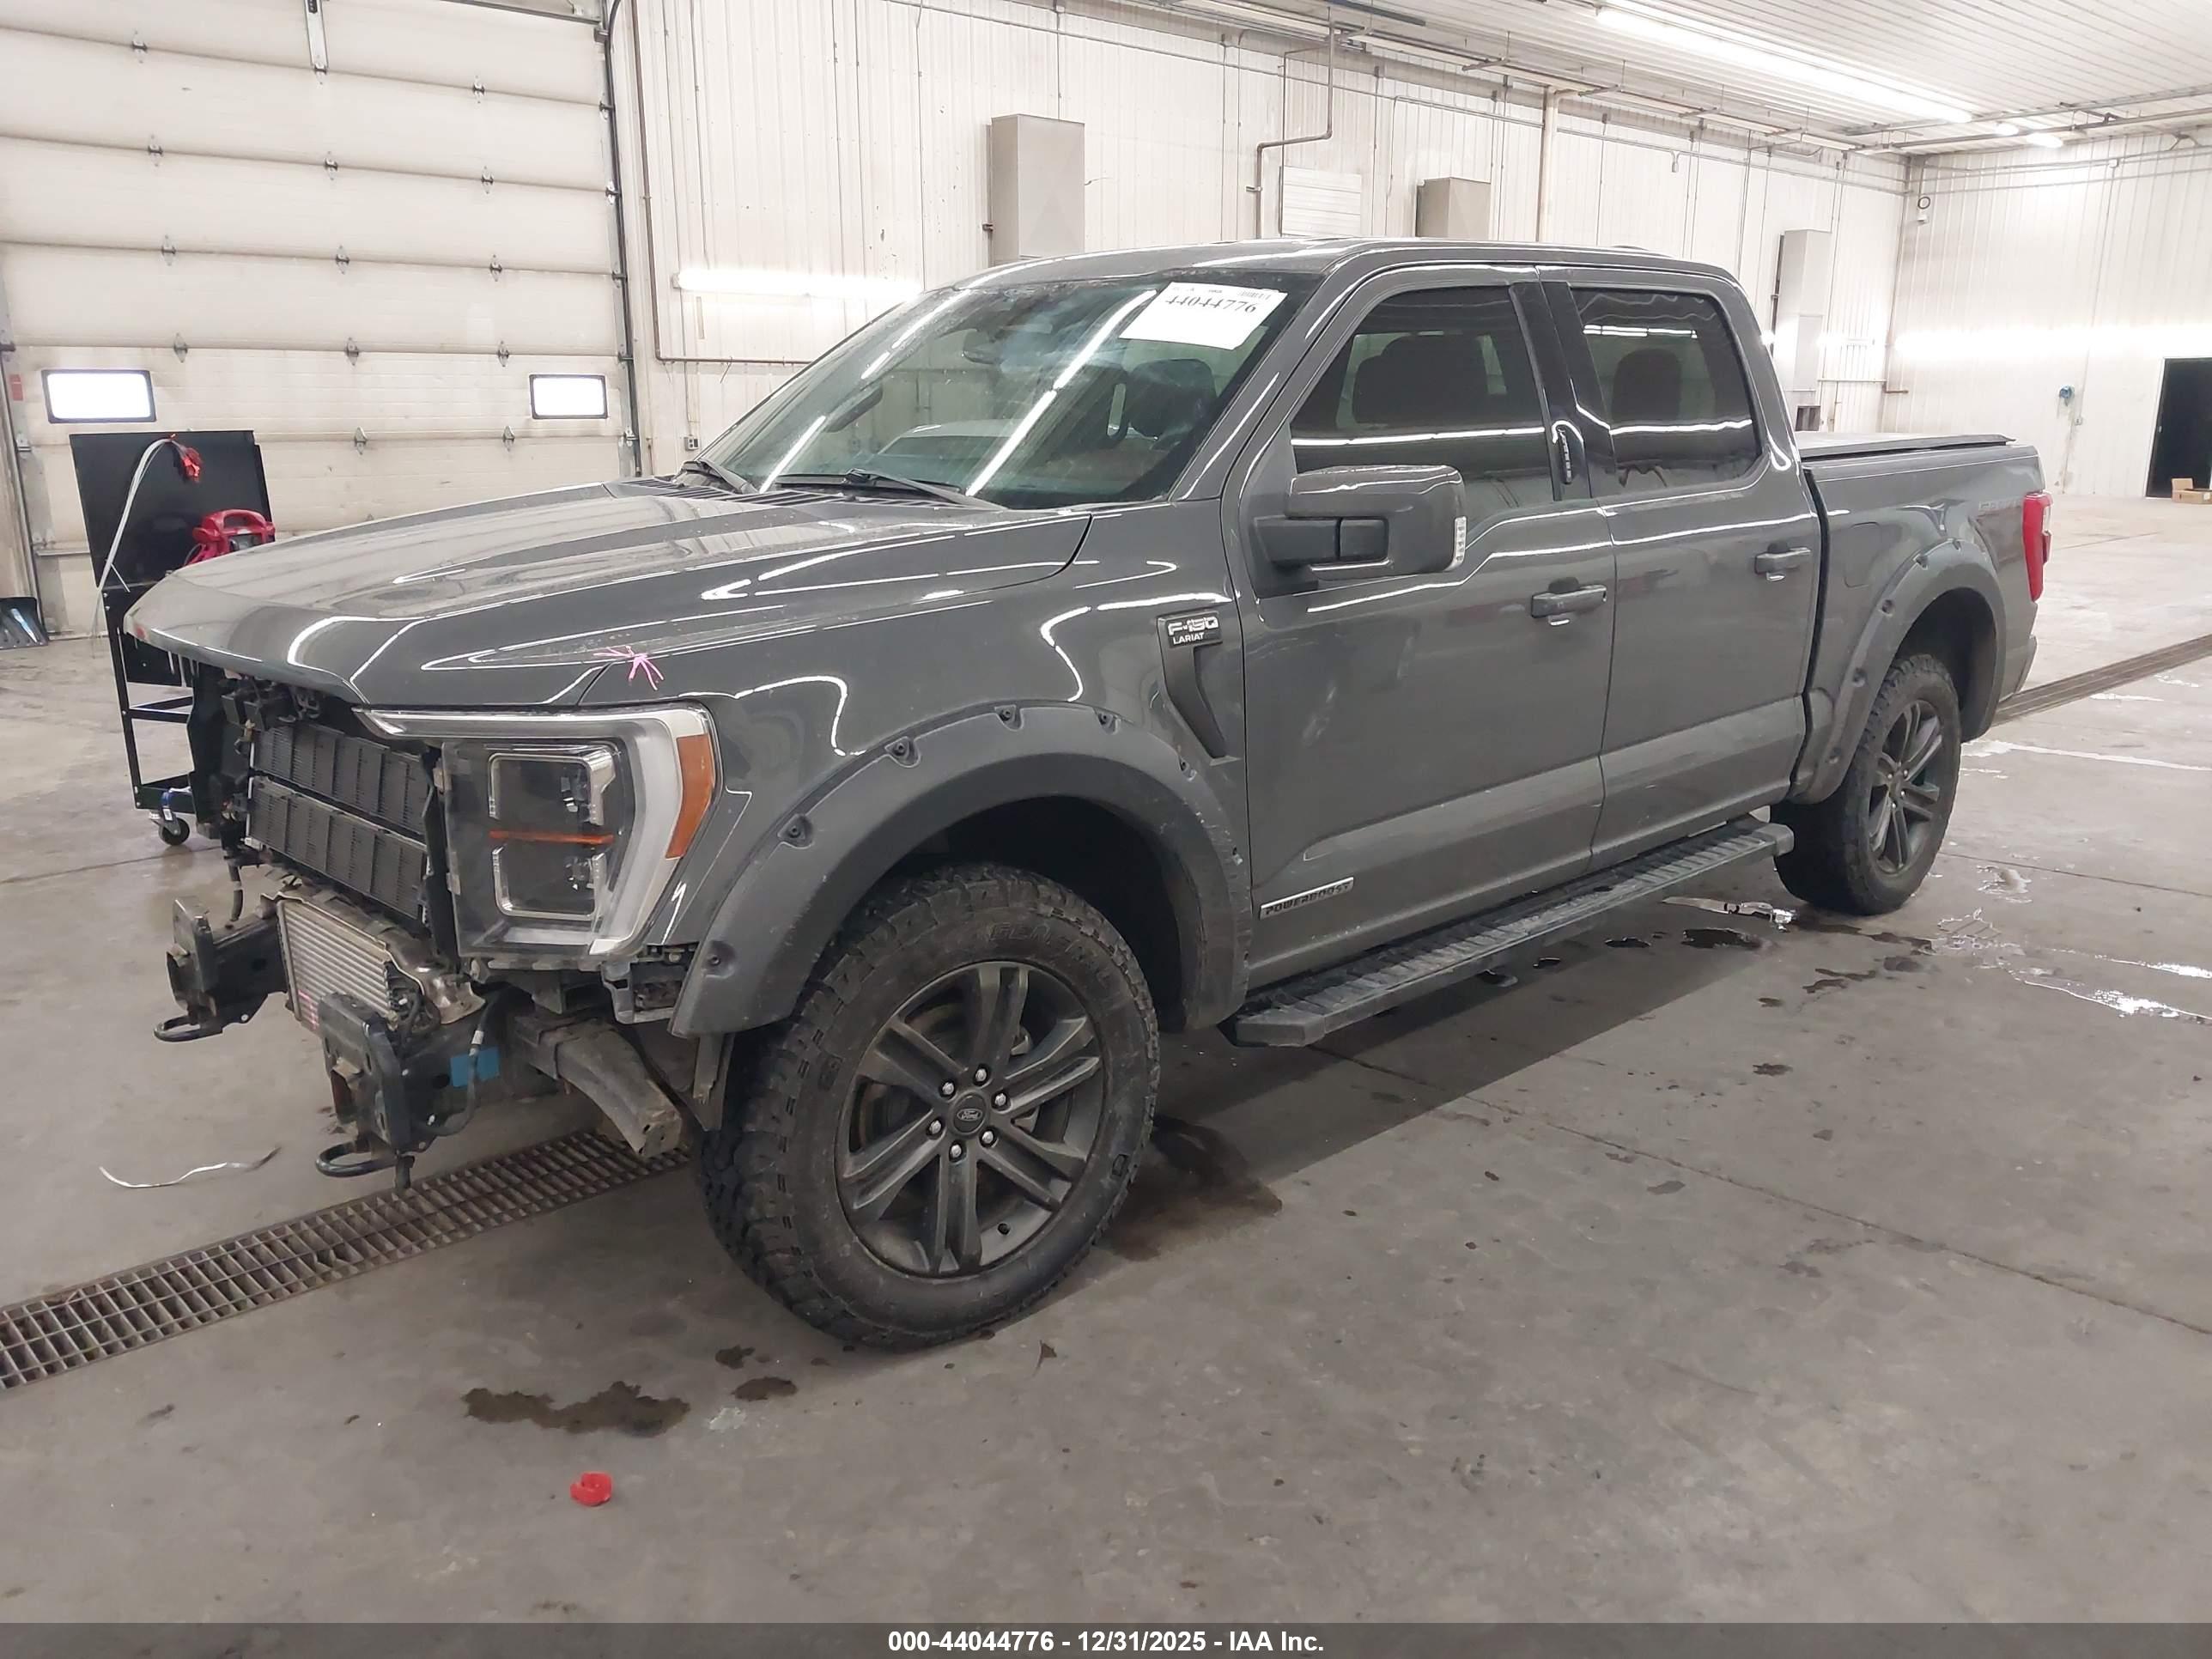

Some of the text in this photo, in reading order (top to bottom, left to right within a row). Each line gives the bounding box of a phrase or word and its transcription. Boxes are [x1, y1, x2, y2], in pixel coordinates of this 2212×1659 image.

[1165, 295, 1257, 313] 44044776
[1168, 617, 1218, 635] F-150
[1172, 632, 1205, 645] LARIAT
